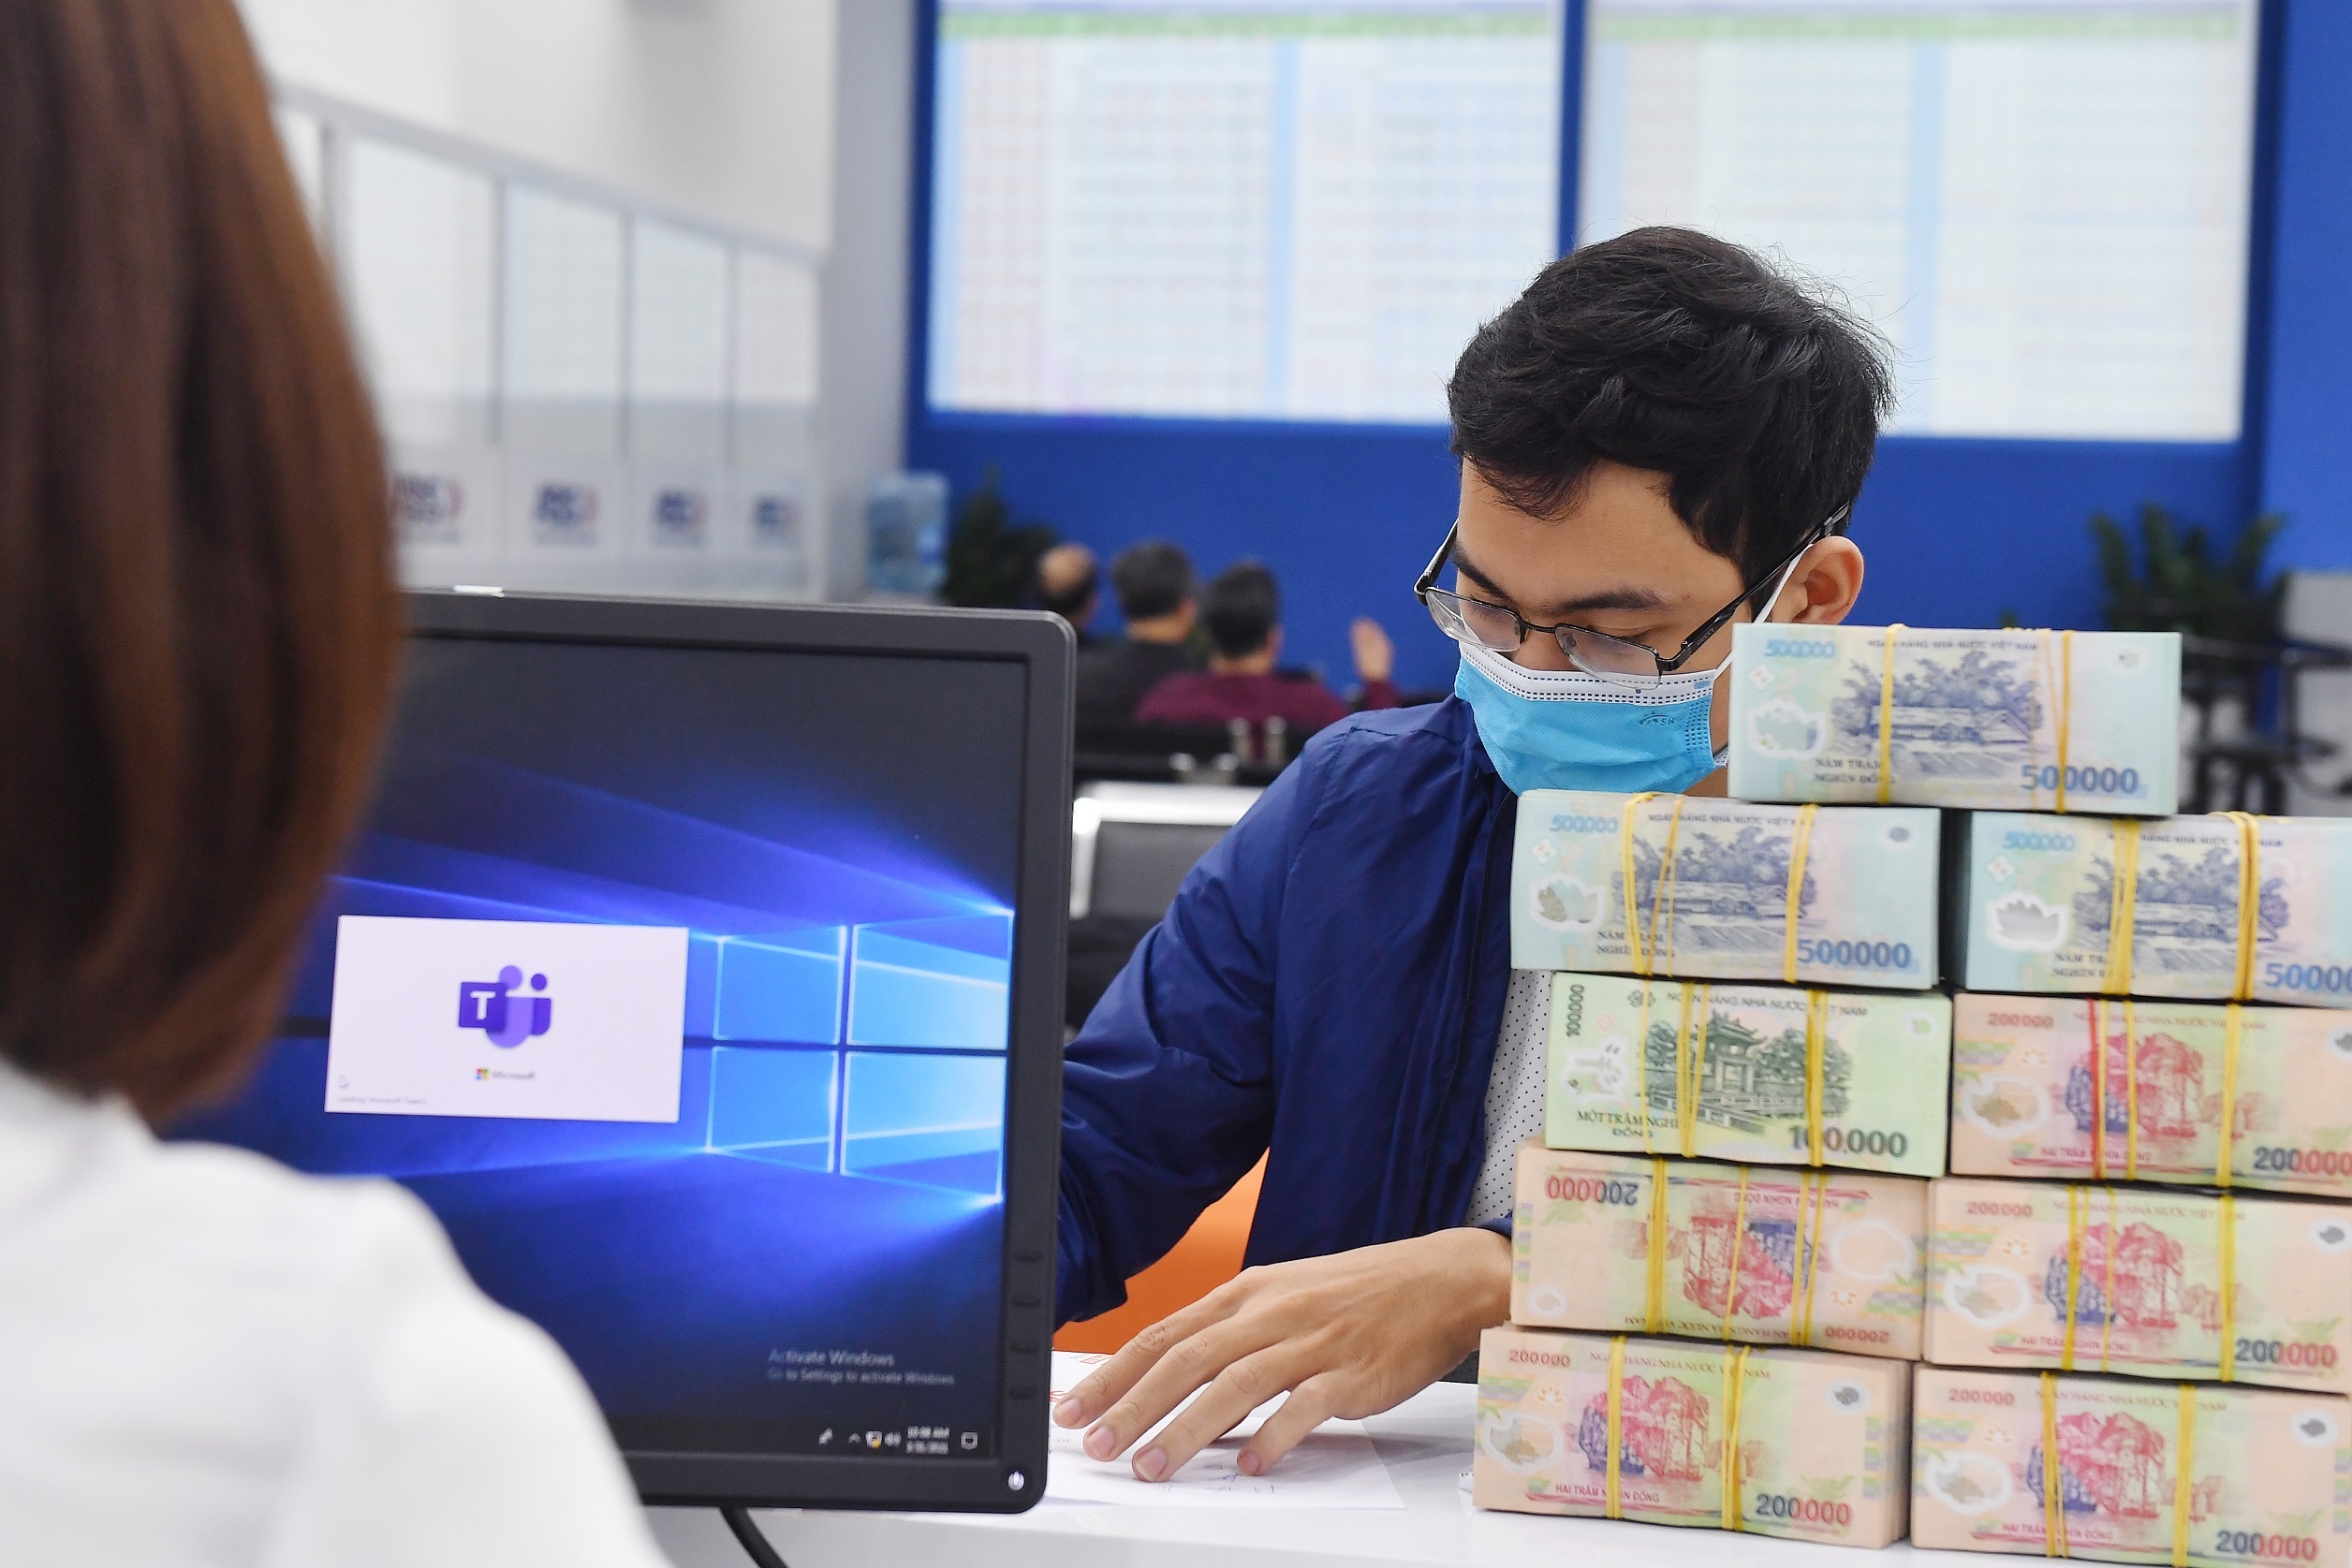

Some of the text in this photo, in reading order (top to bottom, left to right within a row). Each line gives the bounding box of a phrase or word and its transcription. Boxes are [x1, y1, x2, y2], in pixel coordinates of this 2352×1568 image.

[1765, 639, 1836, 657] 500000
[2021, 764, 2139, 793] 500000
[1551, 814, 1618, 833] 500000
[2001, 830, 2076, 851] 500000
[1797, 939, 1911, 968] 500000
[470, 990, 496, 1020] T
[1566, 984, 1584, 1036] 100000
[1988, 1012, 2054, 1028] 200000
[2253, 1147, 2352, 1177] 200000
[1547, 1177, 1639, 1207] 200000
[1968, 1201, 2034, 1218] 200000
[1825, 1326, 1890, 1343] 200000
[768, 1349, 895, 1367] Activate Windows
[1508, 1349, 1571, 1367] 200000
[2234, 1338, 2338, 1369] 200000
[1948, 1388, 2015, 1405] 200000
[1555, 1483, 1572, 1494] HAI
[1756, 1493, 1851, 1525] 200000
[2215, 1530, 2320, 1561] 200000
